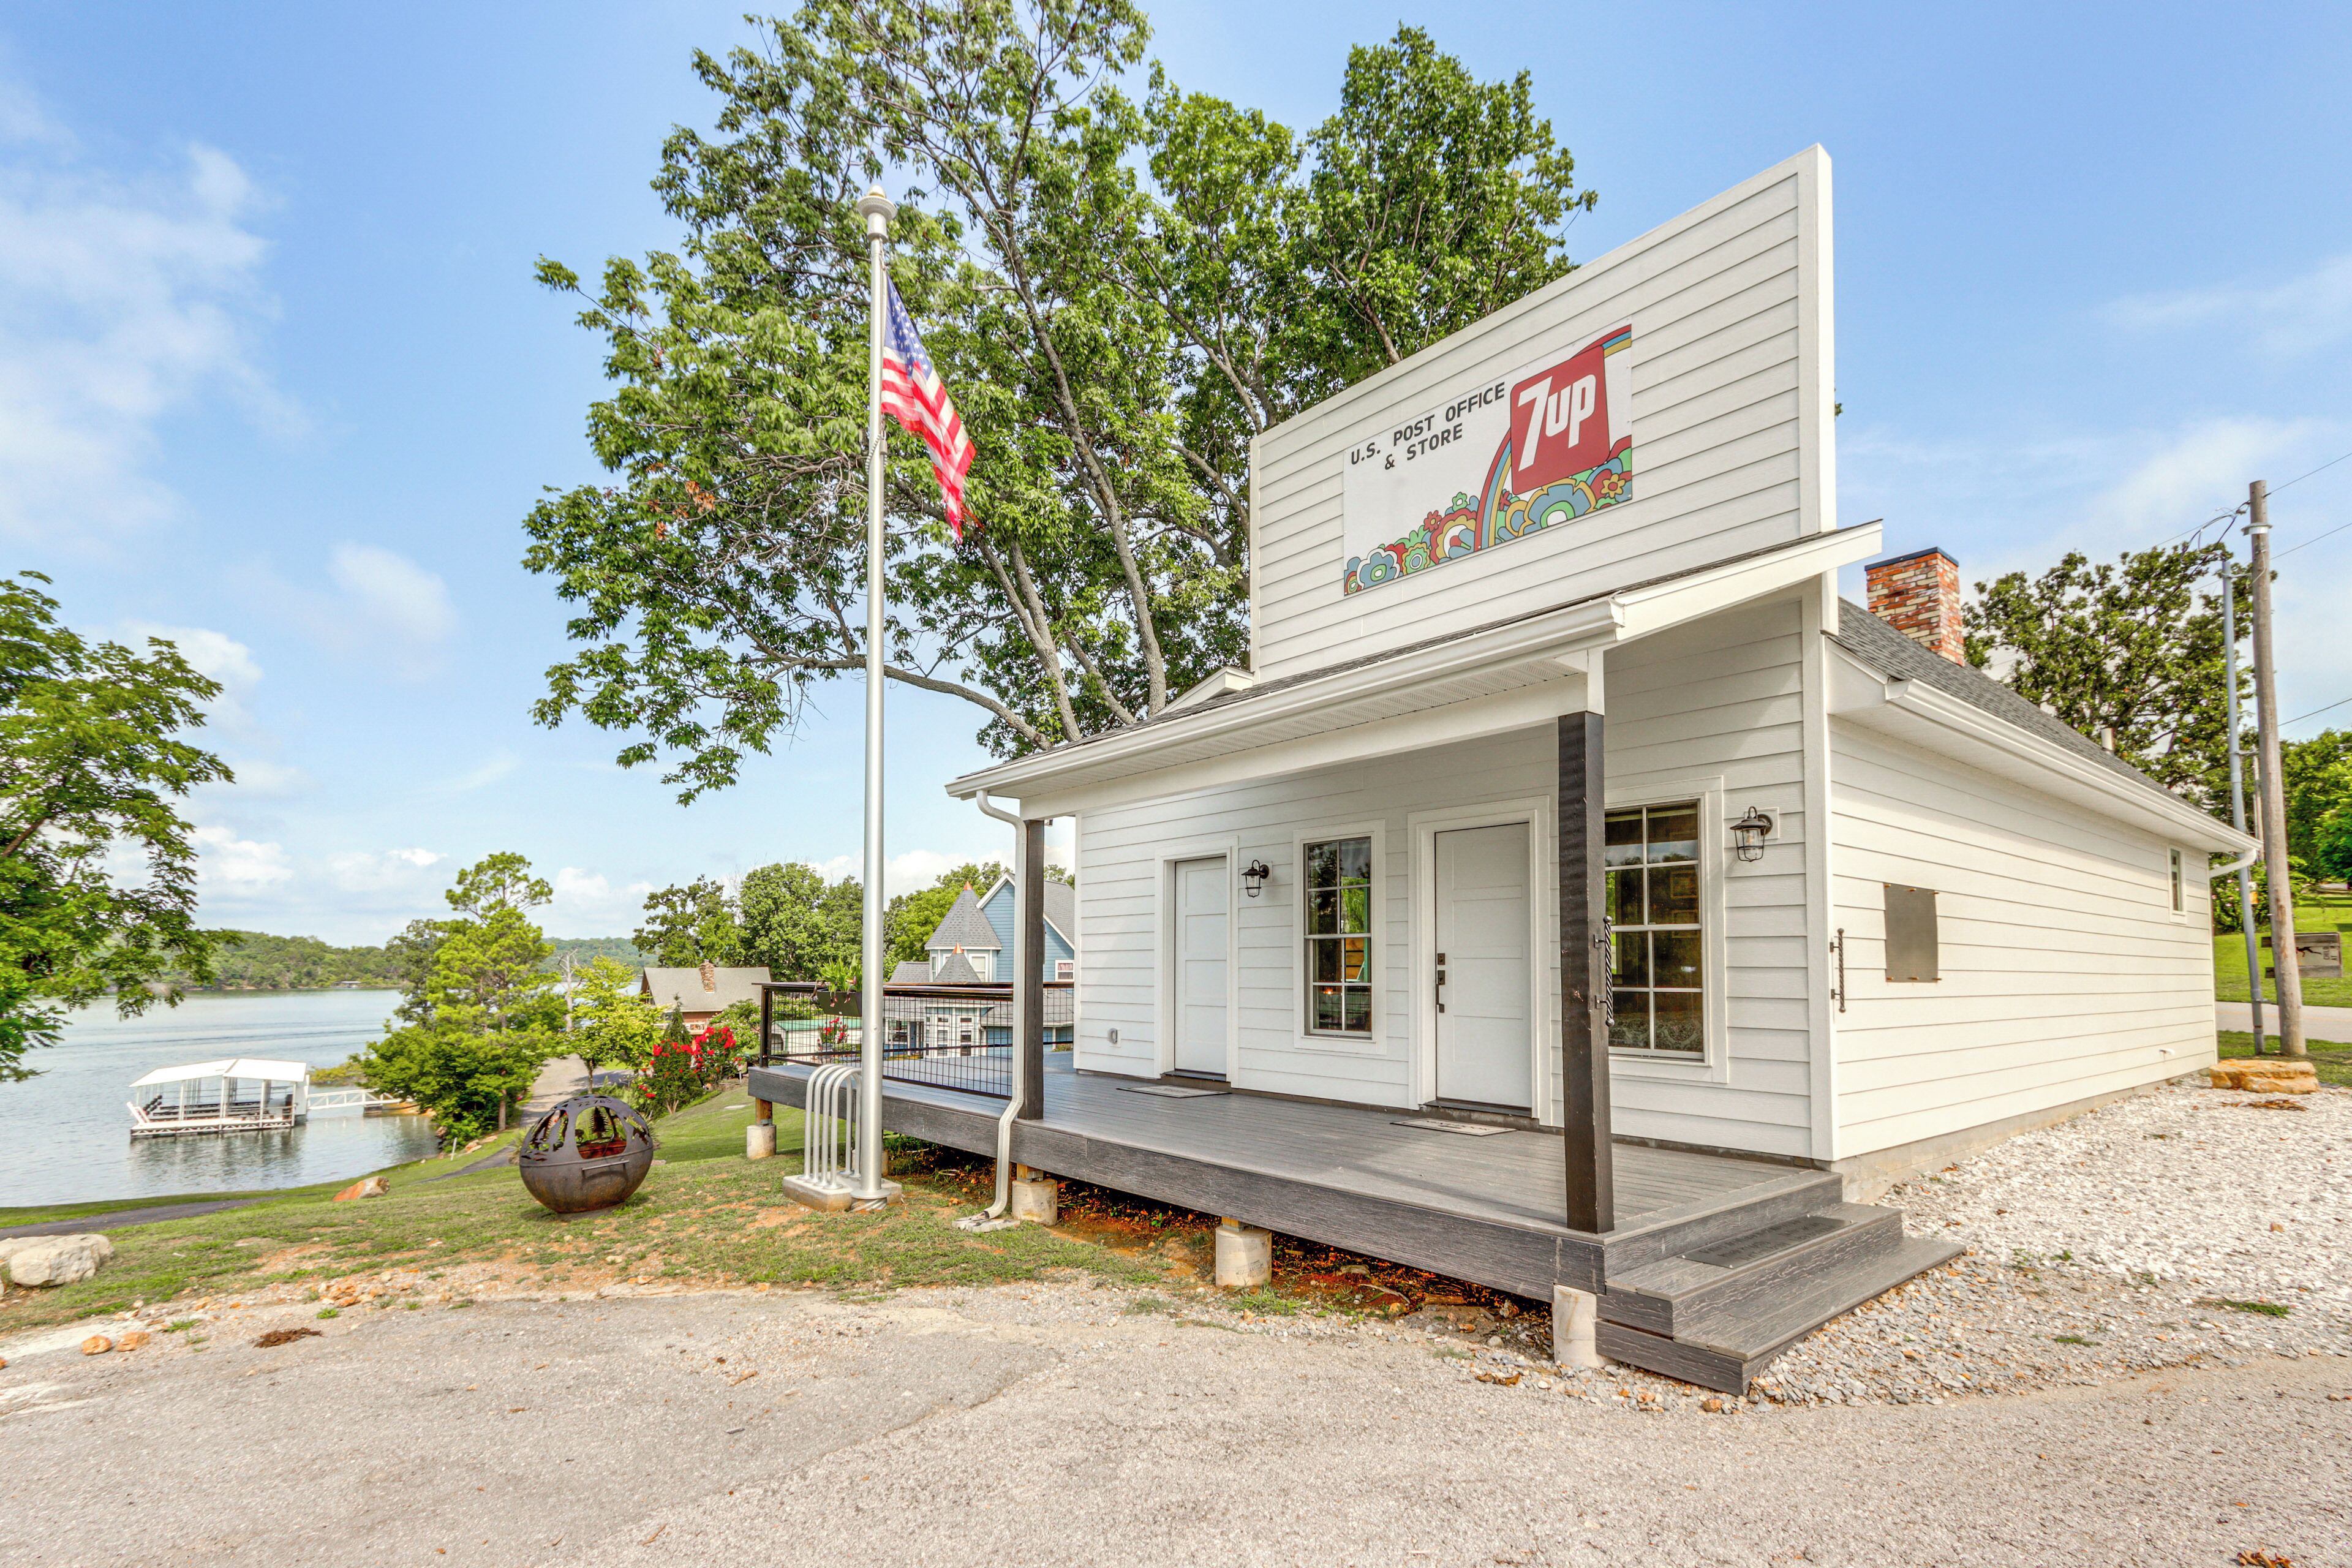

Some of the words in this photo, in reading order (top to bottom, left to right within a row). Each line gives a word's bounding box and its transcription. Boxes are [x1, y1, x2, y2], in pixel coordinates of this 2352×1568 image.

[1351, 442, 1381, 465] U.S.
[1393, 414, 1435, 447] POST
[1446, 382, 1505, 423] OFFICE
[1384, 454, 1395, 470] &
[1407, 423, 1463, 461] STORE
